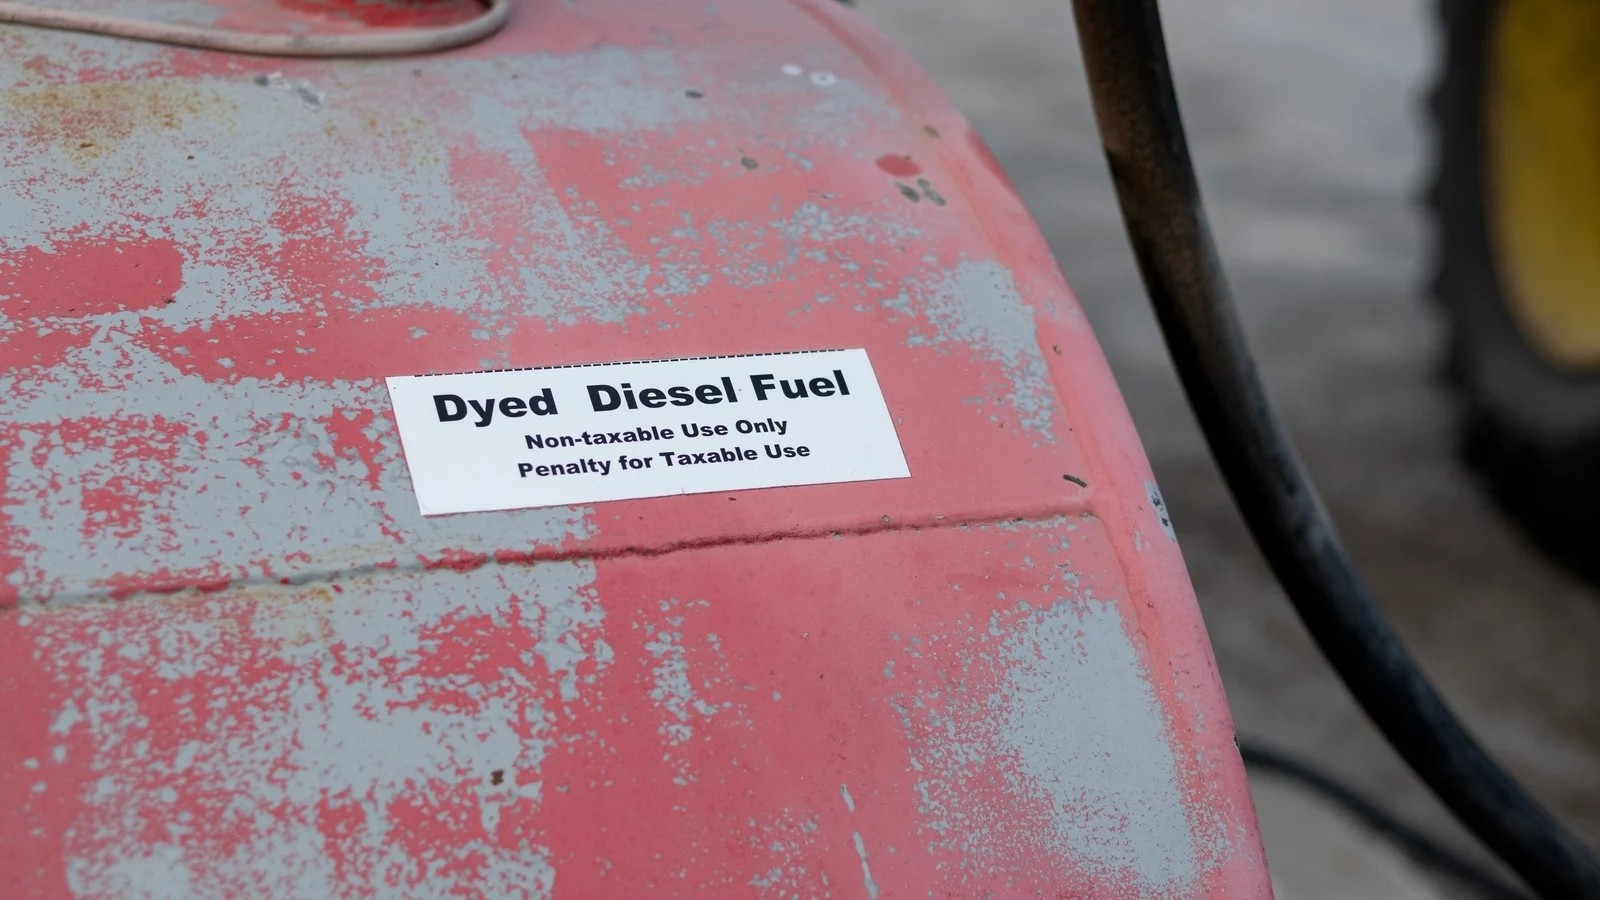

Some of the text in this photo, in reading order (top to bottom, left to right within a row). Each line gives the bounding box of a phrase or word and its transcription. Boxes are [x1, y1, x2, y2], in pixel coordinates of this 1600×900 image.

[432, 370, 850, 427] Dyed Diesel Fuel
[524, 417, 787, 450] Non-taxable Use Only
[517, 443, 811, 478] Penalty for Taxable Use
